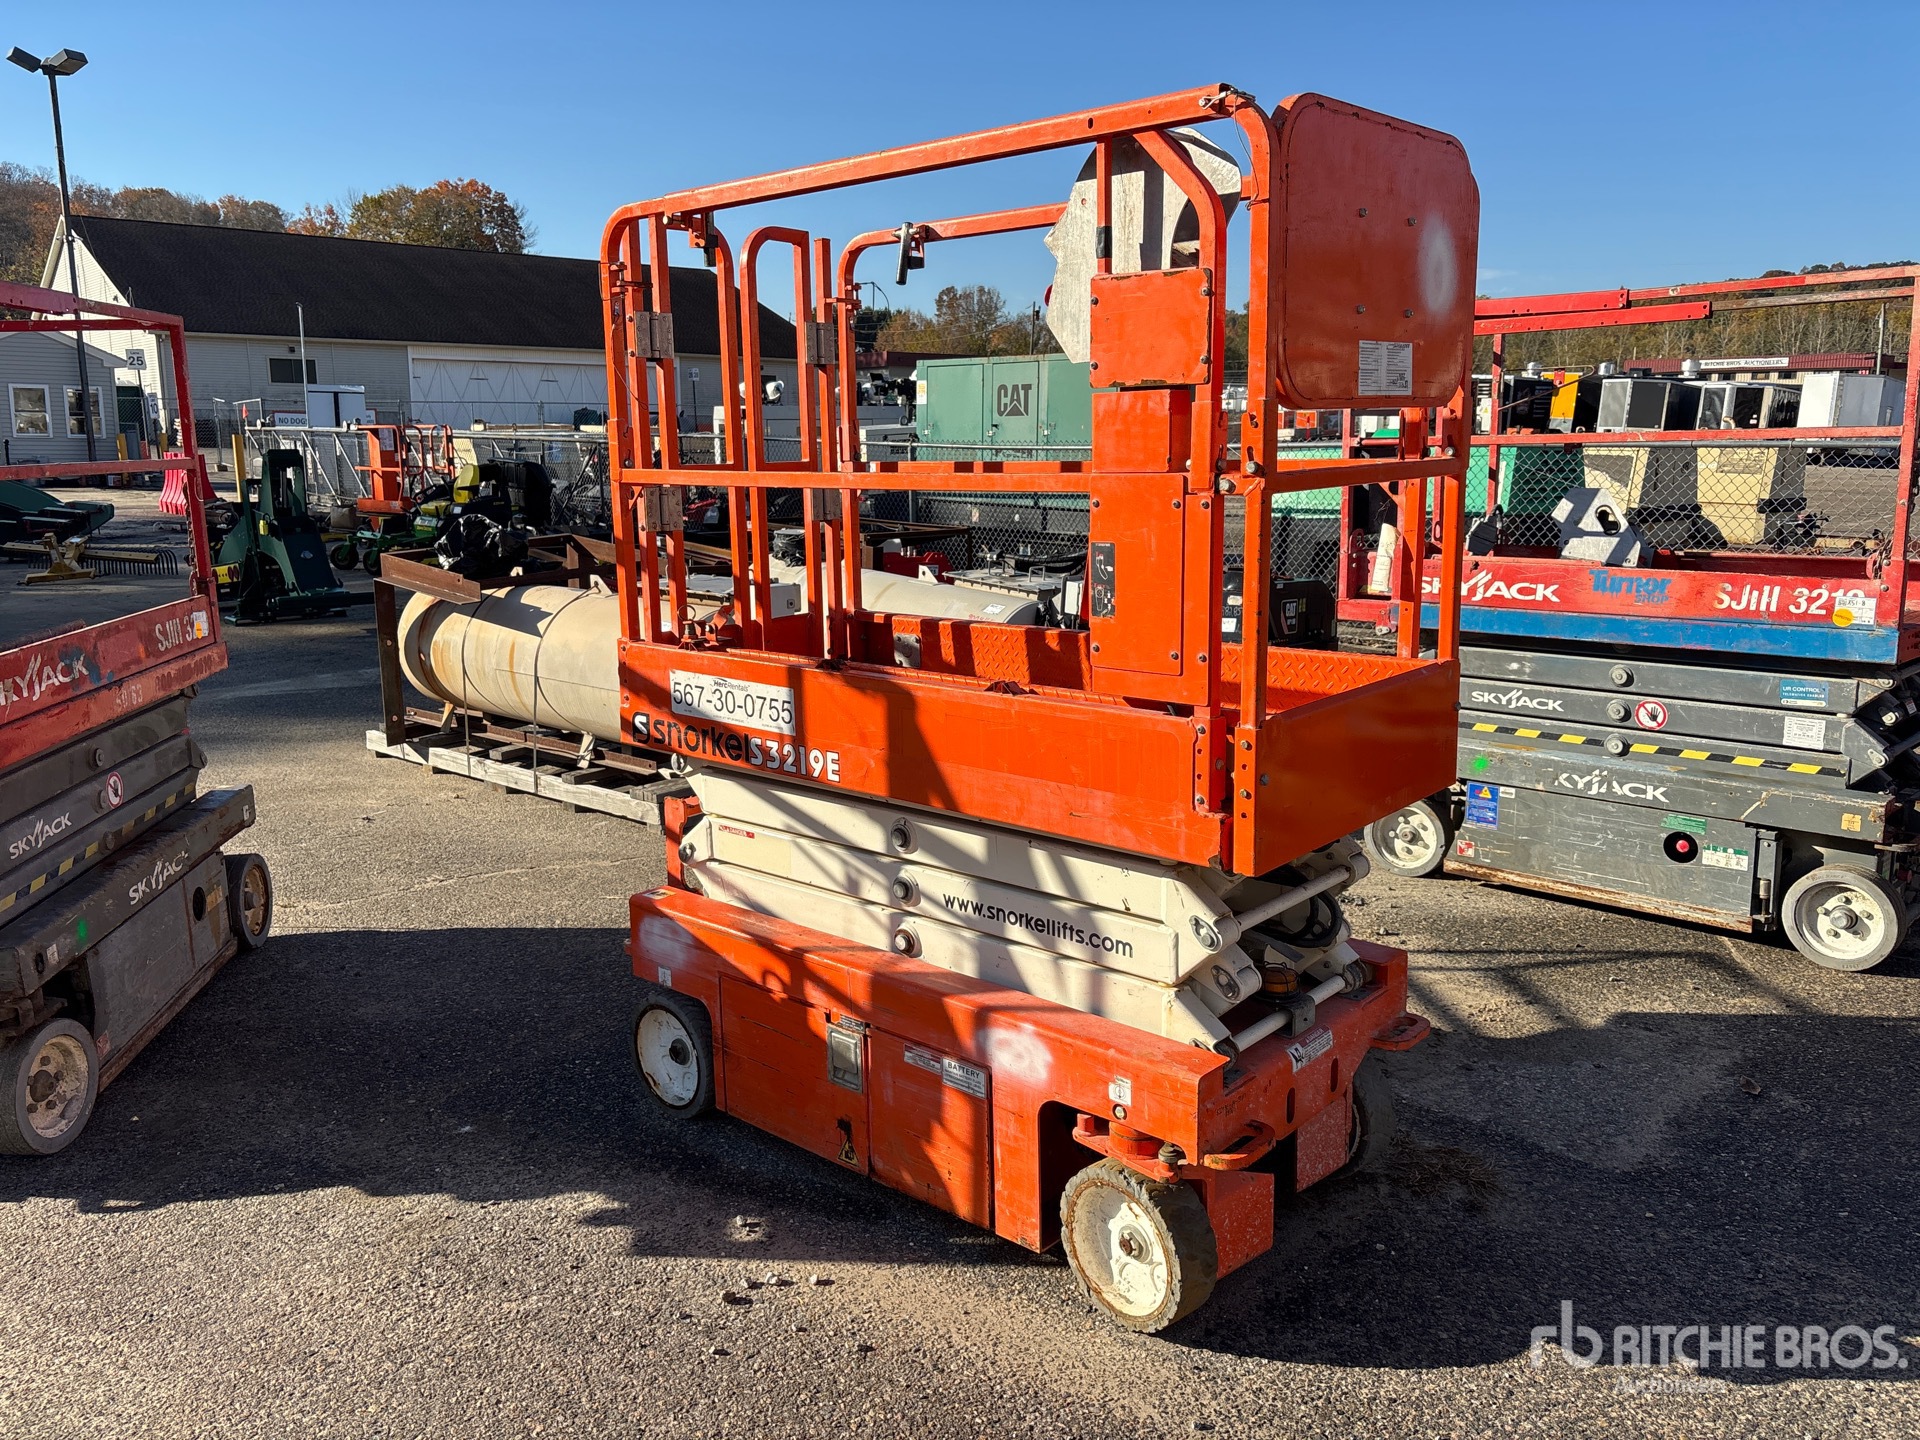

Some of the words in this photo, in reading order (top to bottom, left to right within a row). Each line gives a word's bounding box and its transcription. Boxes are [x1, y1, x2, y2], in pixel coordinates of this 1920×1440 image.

[128, 356, 144, 366] 25
[149, 403, 158, 415] 10
[996, 383, 1033, 417] CAT
[278, 417, 289, 425] NO
[1634, 594, 1669, 605] SHOP
[0, 653, 89, 706] KYJACK
[672, 681, 793, 725] 567-30-0755
[1471, 689, 1565, 712] SKYJACK
[653, 718, 751, 763] snorkel
[750, 736, 841, 783] S3219E
[1553, 768, 1670, 803] KYJACK
[9, 812, 73, 860] SKYJACK
[943, 893, 1134, 959] www.snorkellifts.com
[947, 1061, 981, 1079] BATTERY
